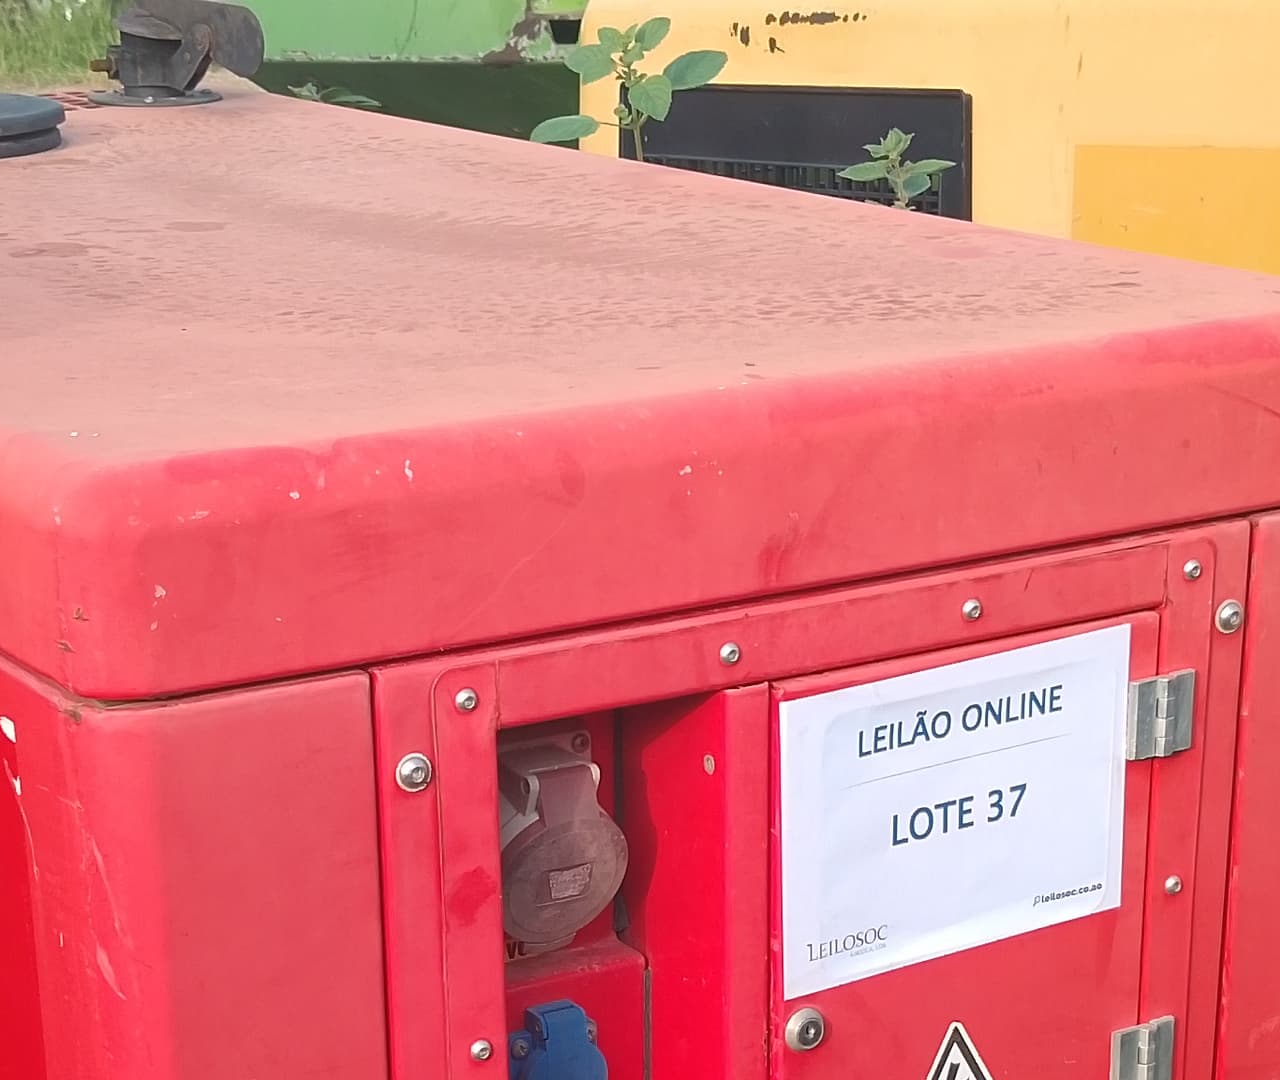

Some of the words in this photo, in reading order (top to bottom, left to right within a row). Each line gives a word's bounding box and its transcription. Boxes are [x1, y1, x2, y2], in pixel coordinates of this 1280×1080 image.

[858, 708, 952, 758] LEILÃO
[961, 684, 1063, 732] ONLINE
[891, 795, 975, 847] LOTE
[986, 783, 1028, 823] 37
[806, 924, 888, 962] LEILOSOC
